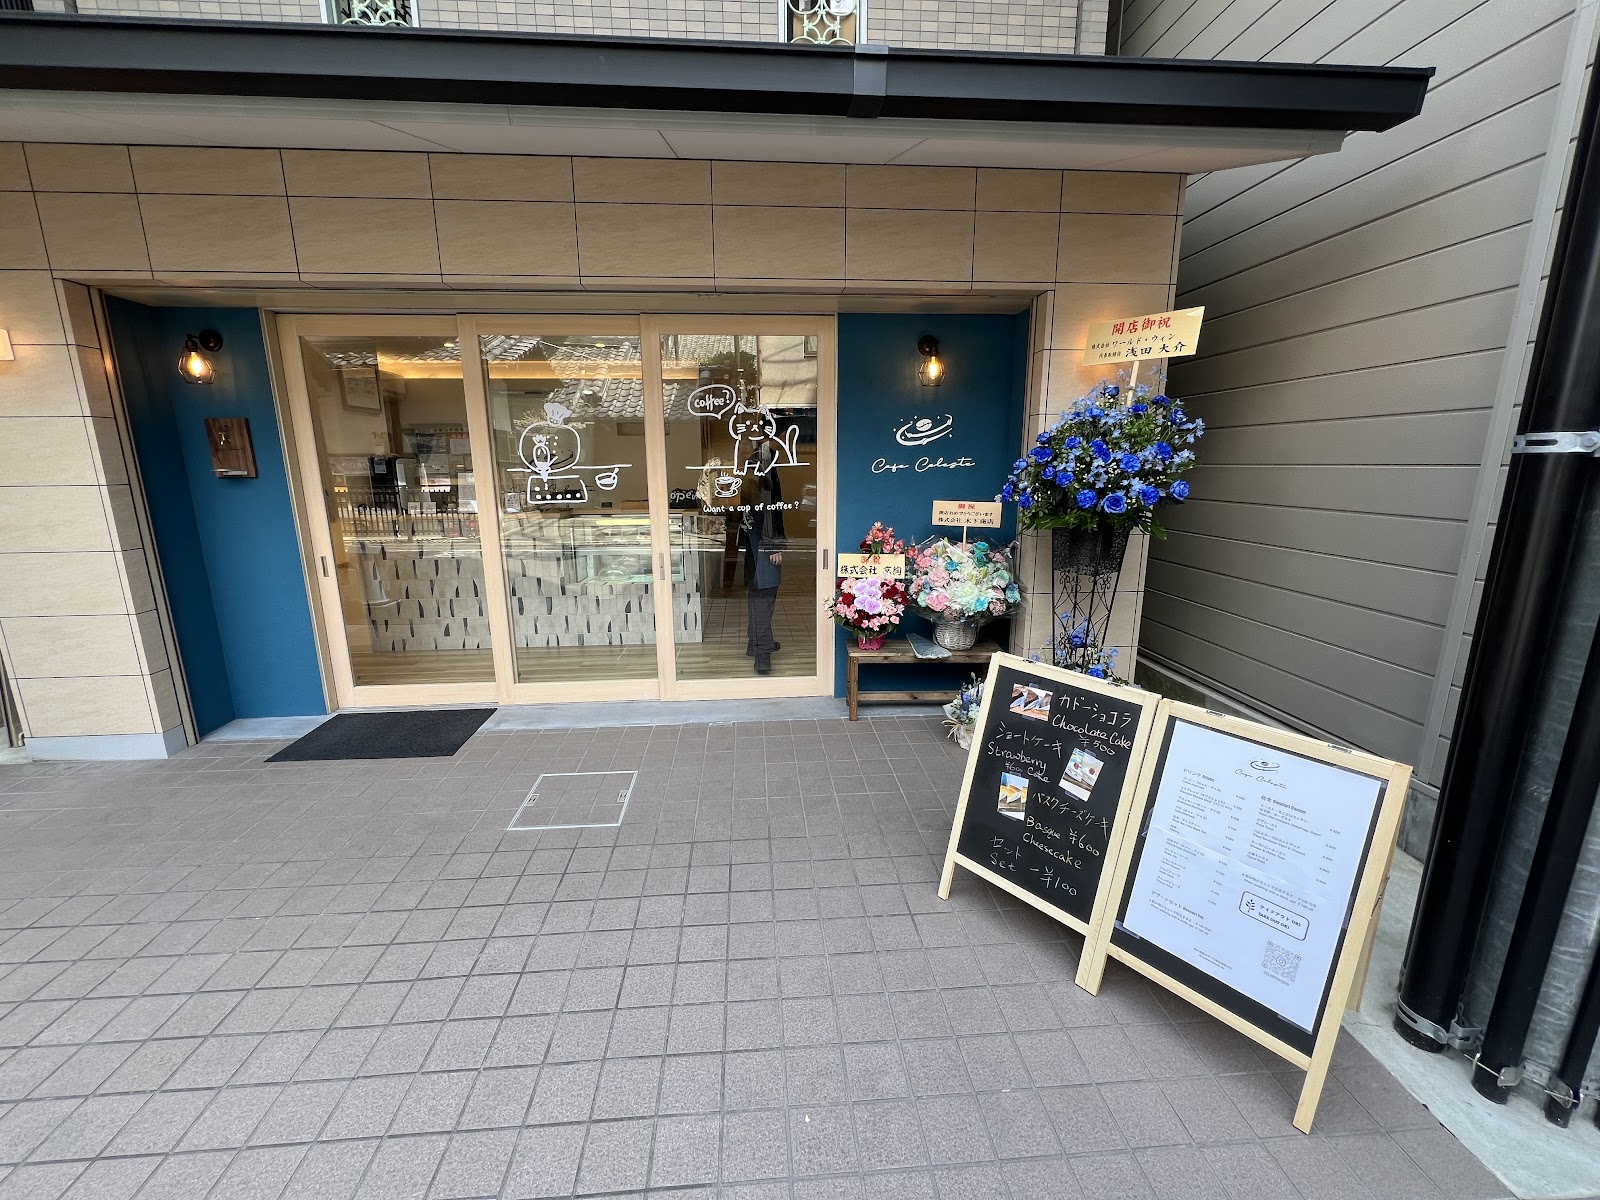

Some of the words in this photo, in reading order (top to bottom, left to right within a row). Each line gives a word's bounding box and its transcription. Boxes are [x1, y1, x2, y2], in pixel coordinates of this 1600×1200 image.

[1111, 316, 1172, 336] 開店御祝
[1112, 333, 1176, 348] ワールド・ウィン
[694, 389, 731, 412] coffee?
[914, 456, 976, 473] Celeste
[703, 504, 726, 513] Want
[737, 504, 751, 516] cup
[754, 503, 765, 511] of
[840, 565, 878, 575] 株式会社
[996, 721, 1063, 758] ショートケーキ
[1052, 714, 1108, 740] Chocolate
[1109, 732, 1132, 750] Cake
[988, 741, 1047, 773] Strawberry
[1026, 816, 1060, 840] Basque
[990, 836, 1022, 860] セット
[1022, 832, 1083, 870] Cheesecake
[990, 852, 1017, 872] Set
